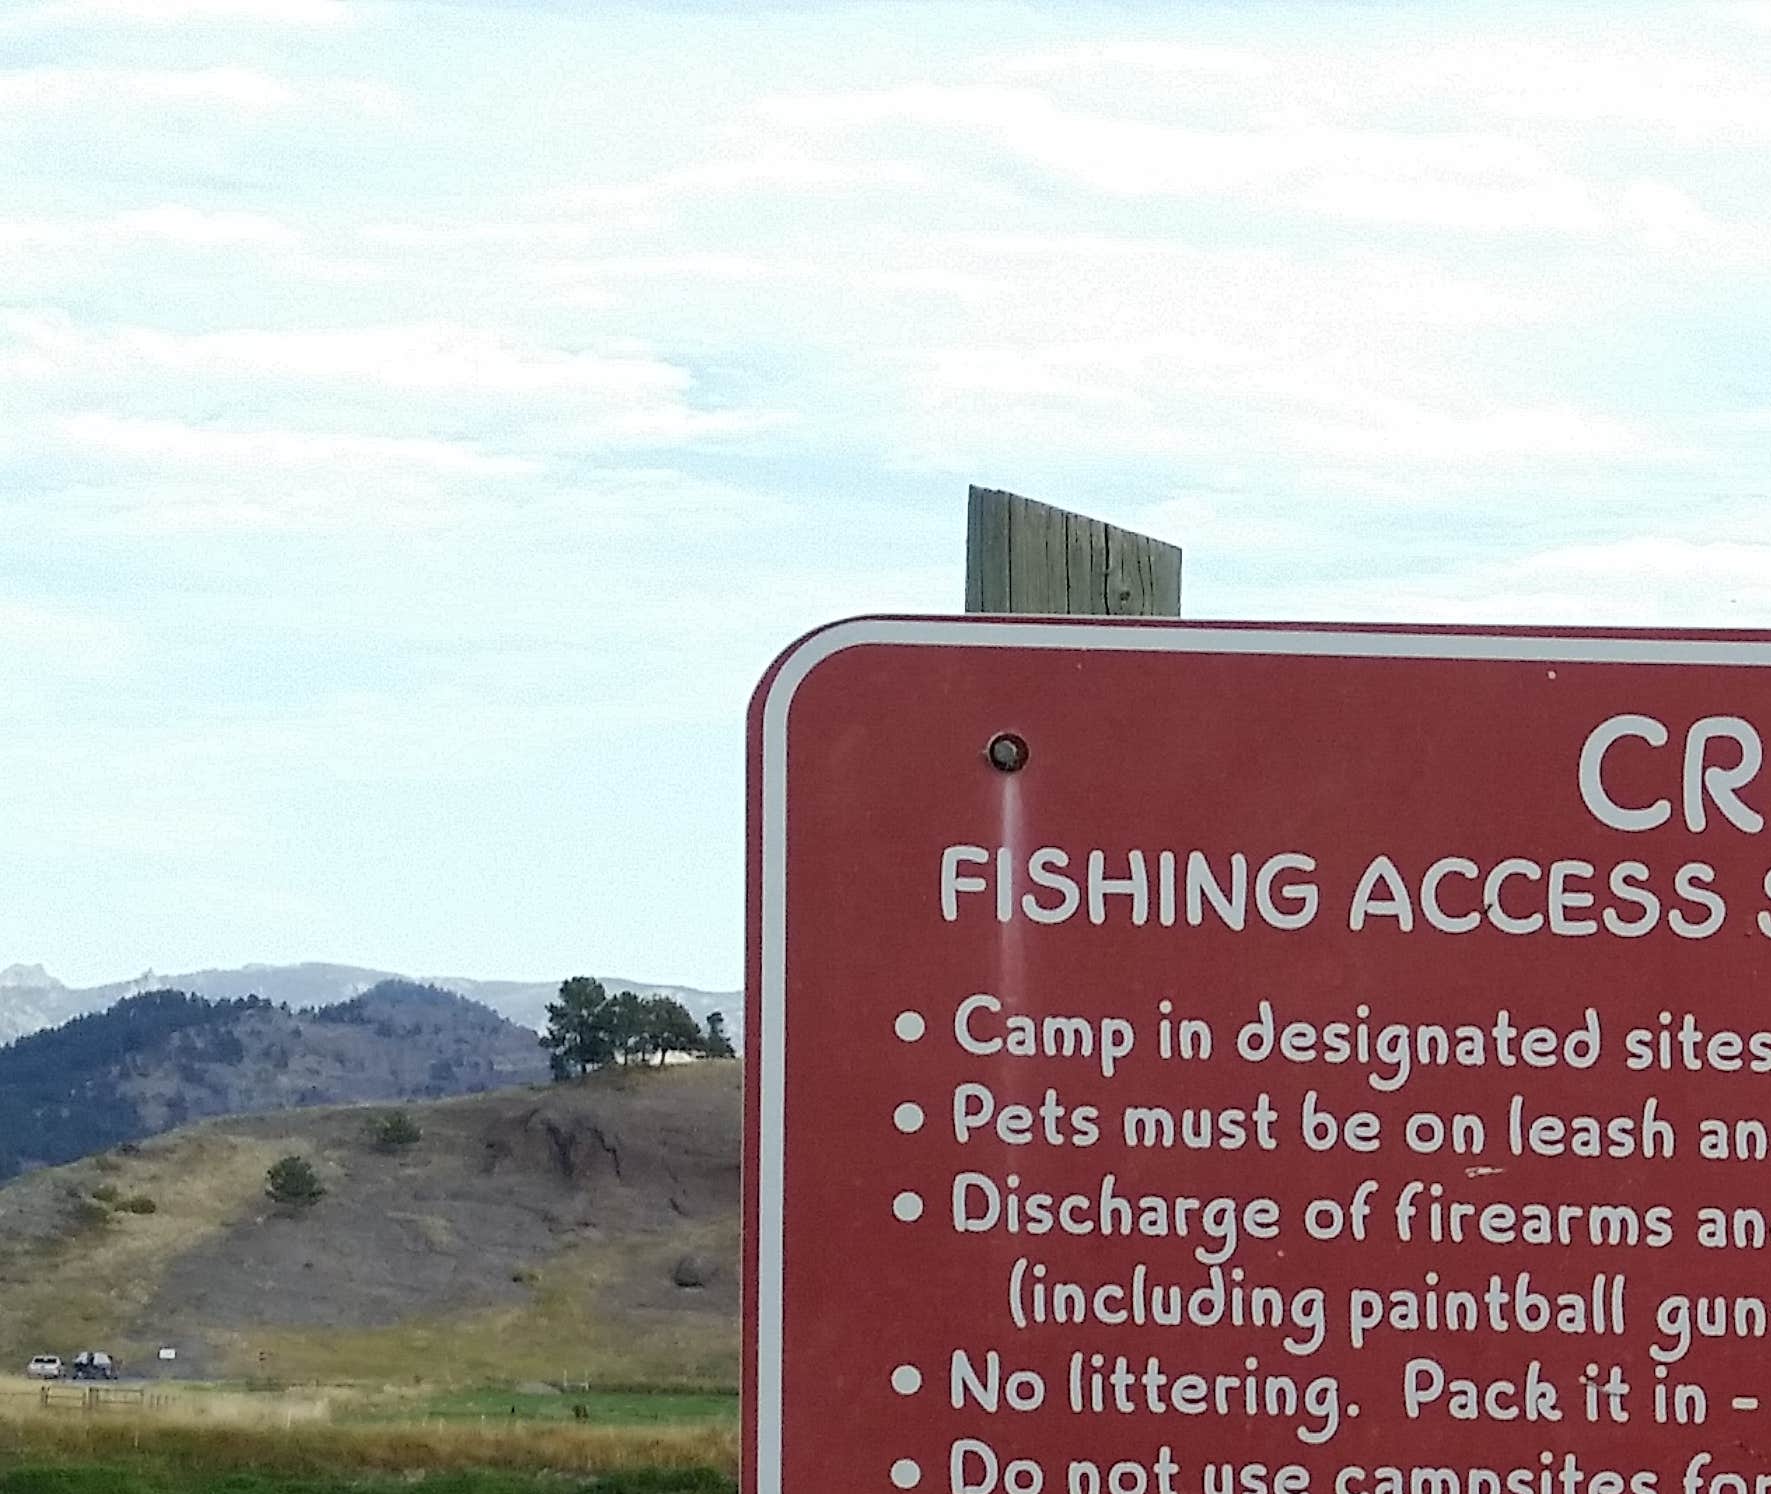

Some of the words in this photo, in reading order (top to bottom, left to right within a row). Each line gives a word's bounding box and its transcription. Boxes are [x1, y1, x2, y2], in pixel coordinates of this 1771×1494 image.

[939, 845, 1320, 932] FISHING
[1348, 854, 1727, 940] ACCESS
[953, 993, 1135, 1079] Camp
[1158, 999, 1213, 1061] in
[1236, 999, 1601, 1093] designated
[952, 1082, 1100, 1147] Pets
[1123, 1092, 1279, 1151] must
[1301, 1089, 1382, 1153] be
[1404, 1112, 1486, 1155] on
[1508, 1094, 1675, 1159] leash
[951, 1171, 1281, 1266] Discharge
[1303, 1179, 1380, 1241] of
[1394, 1180, 1674, 1248] firearms
[1008, 1257, 1326, 1356] (including
[1349, 1270, 1626, 1350] paintball
[950, 1348, 1046, 1414] No
[1068, 1350, 1361, 1445] littering.
[1403, 1357, 1564, 1422] Pack
[1585, 1362, 1631, 1424] it
[1654, 1364, 1708, 1425] in
